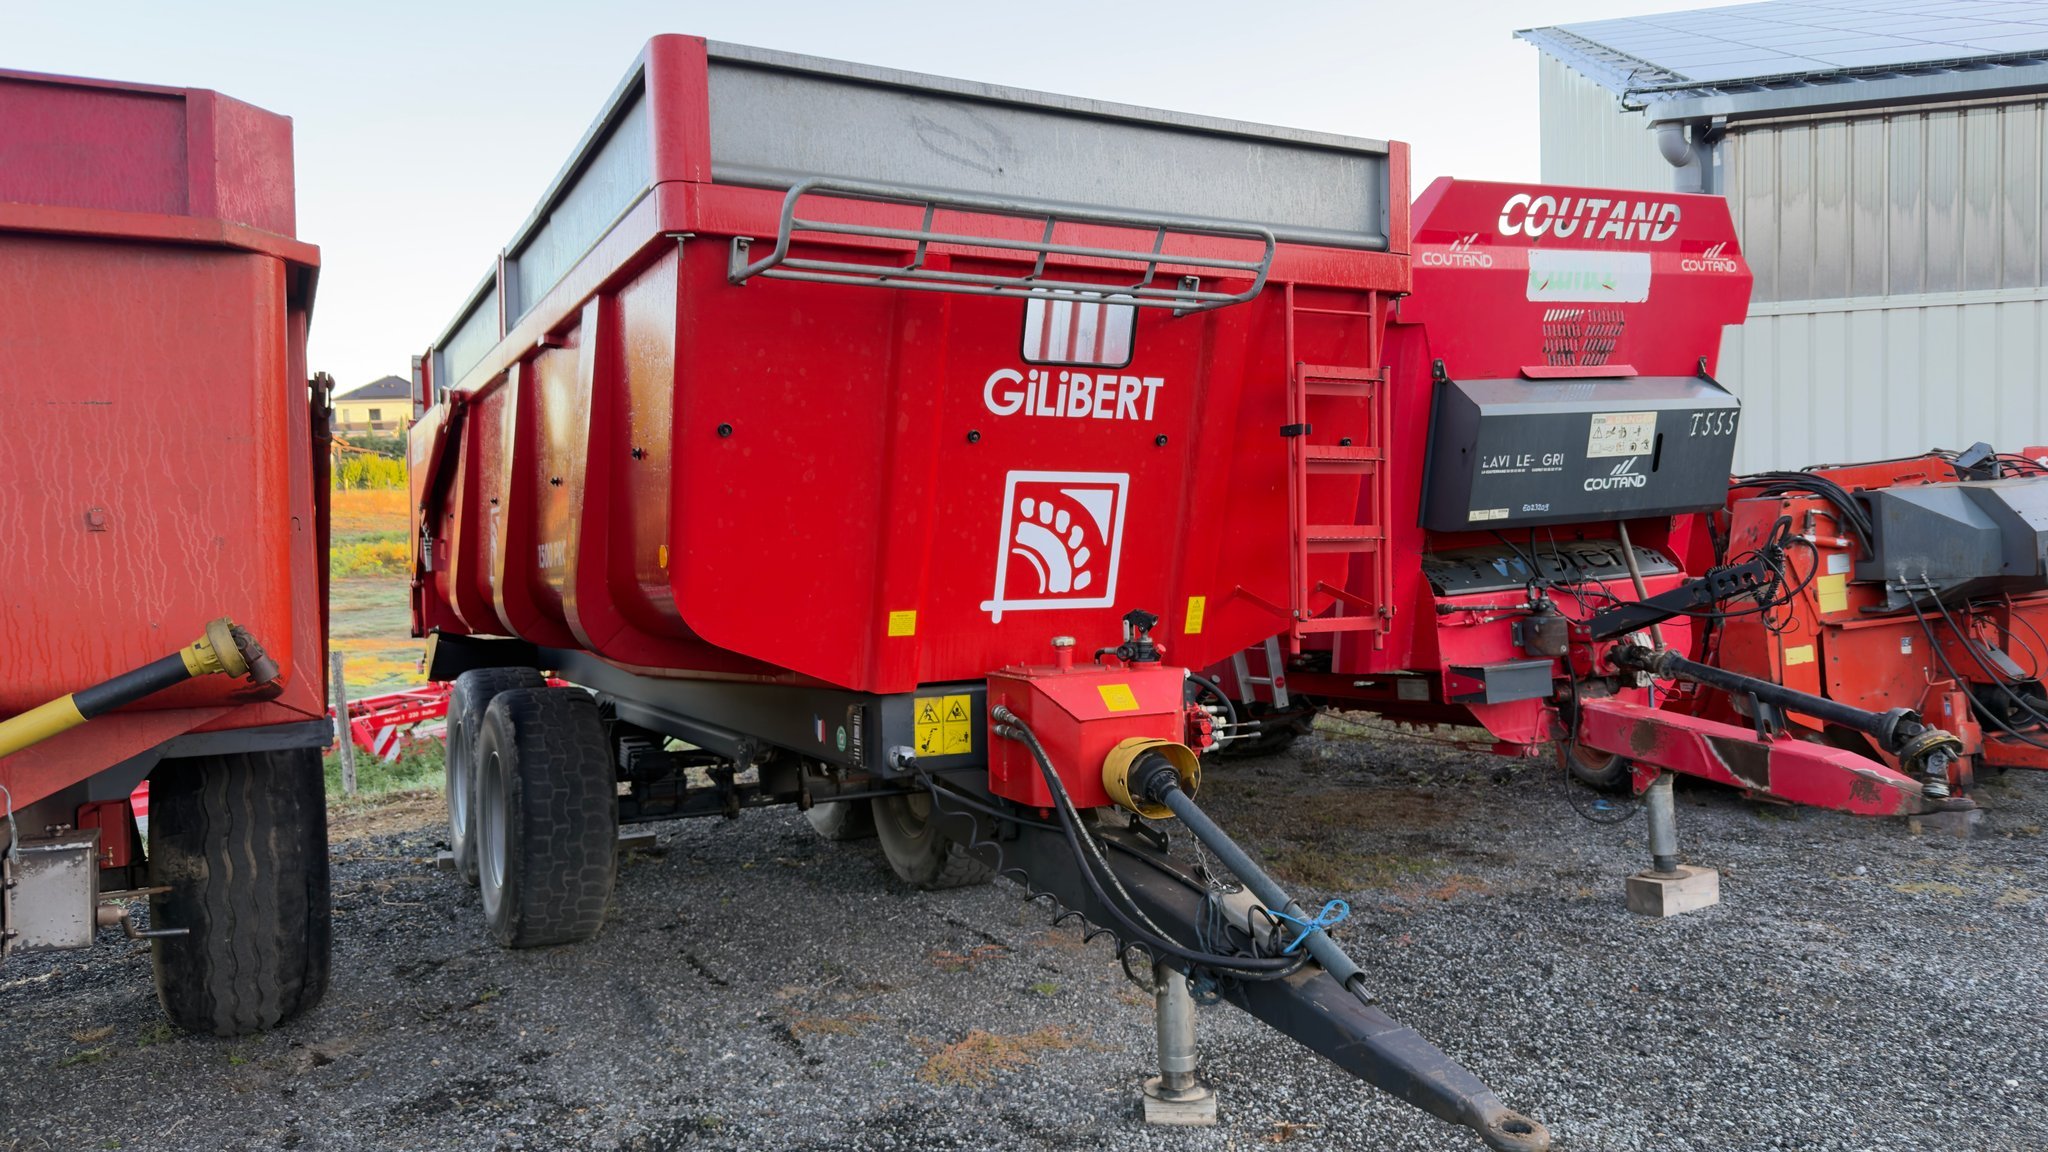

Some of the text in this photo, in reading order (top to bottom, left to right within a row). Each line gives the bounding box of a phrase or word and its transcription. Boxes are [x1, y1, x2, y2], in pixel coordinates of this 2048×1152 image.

[1498, 193, 1681, 241] COUTAND
[1421, 252, 1493, 268] COUTAND
[1681, 259, 1737, 272] COUTAND
[1584, 475, 1647, 491] COUTAND
